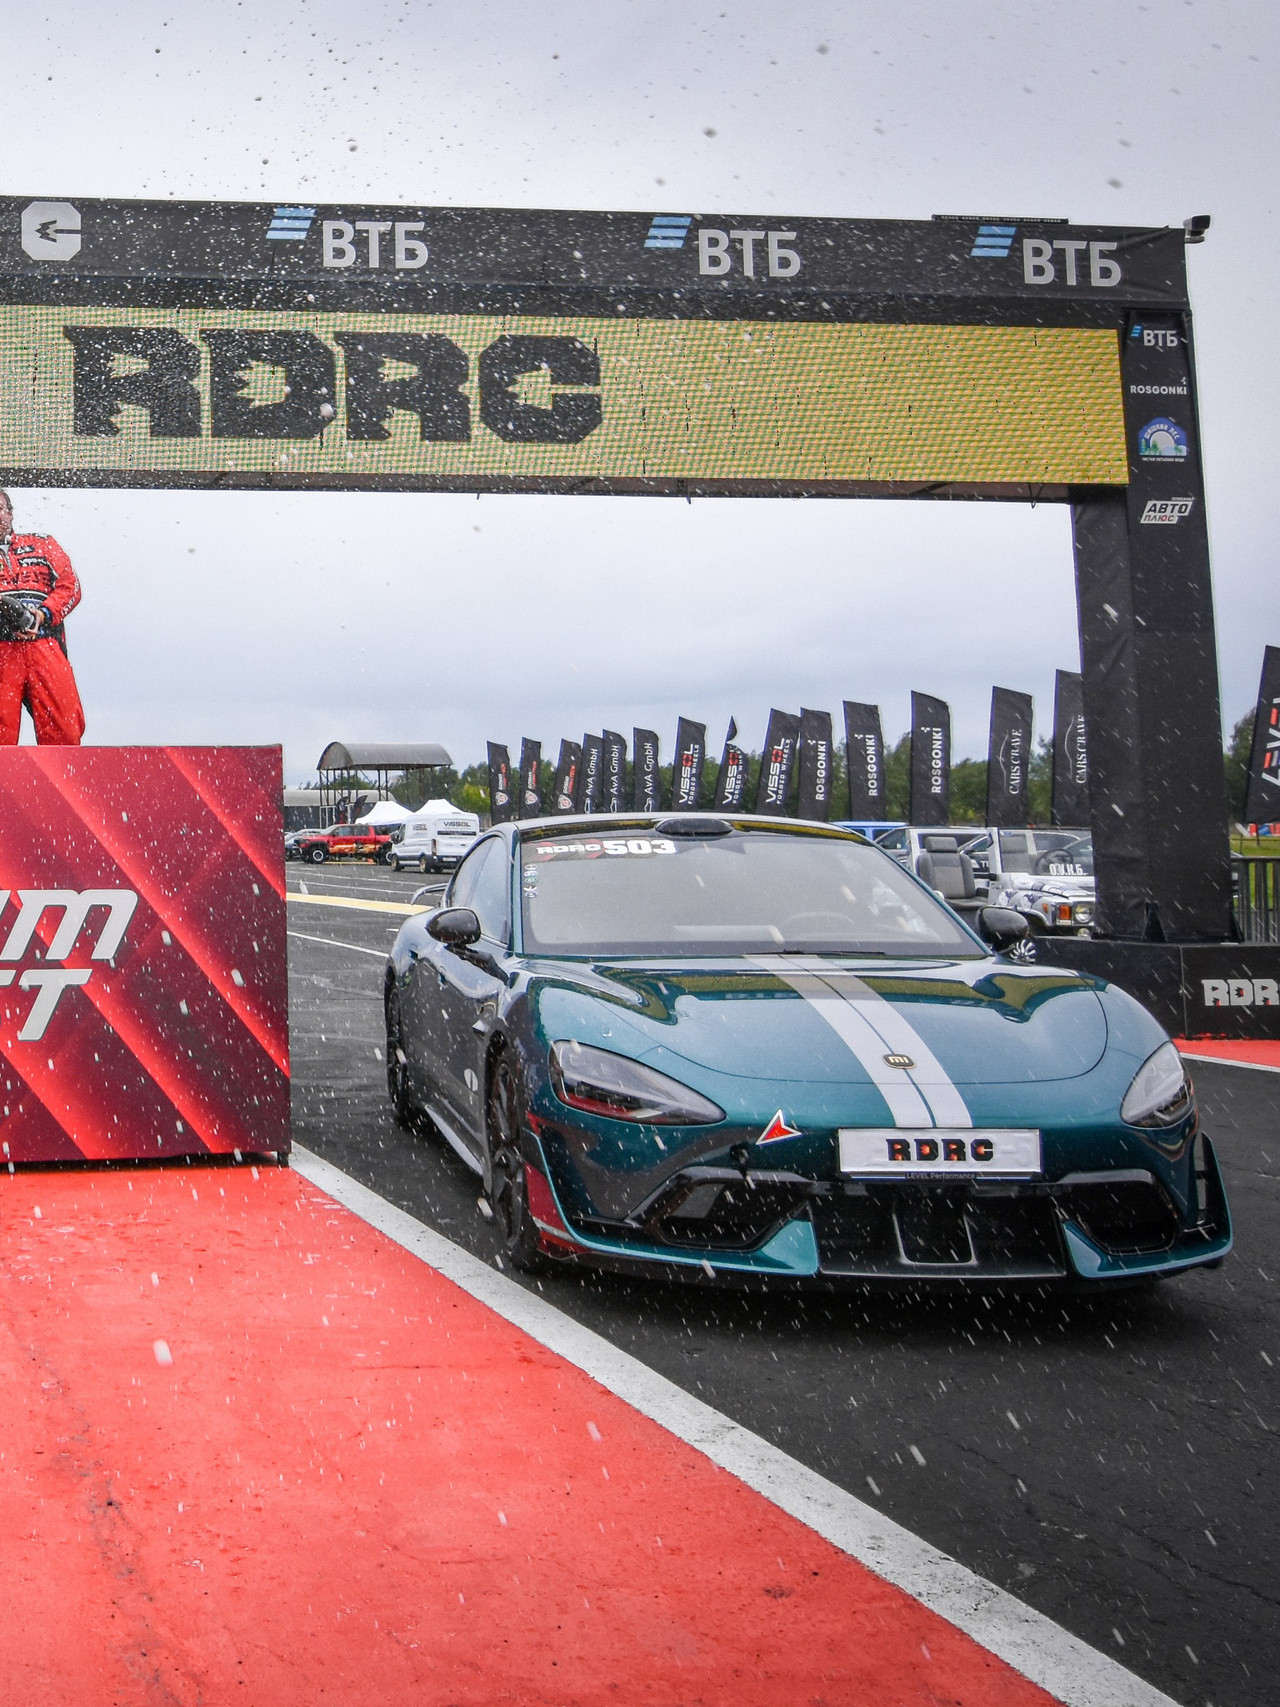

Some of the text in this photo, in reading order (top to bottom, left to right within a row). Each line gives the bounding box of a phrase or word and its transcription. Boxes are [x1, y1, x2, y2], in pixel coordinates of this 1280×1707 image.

[321, 219, 429, 270] ВТБ
[698, 229, 801, 278] ВТБ
[1022, 238, 1121, 288] ВТБ
[1143, 329, 1178, 347] ВТБ
[62, 325, 601, 444] RDRC
[1130, 385, 1187, 395] ROSGONKI
[1146, 503, 1189, 514] АВТО
[586, 748, 598, 795] AvA GmbH
[610, 745, 619, 795] AvA GmbH
[644, 743, 653, 795] AvA GmbH
[679, 743, 693, 803] VISSOL
[766, 738, 785, 803] VISSOL
[815, 740, 826, 801] ROSGONKI
[865, 735, 878, 796] ROSGONKI
[931, 727, 942, 794] ROSGONKI
[1009, 765, 1020, 795] CARS
[602, 839, 677, 855] 503
[886, 1138, 994, 1162] RDRC
